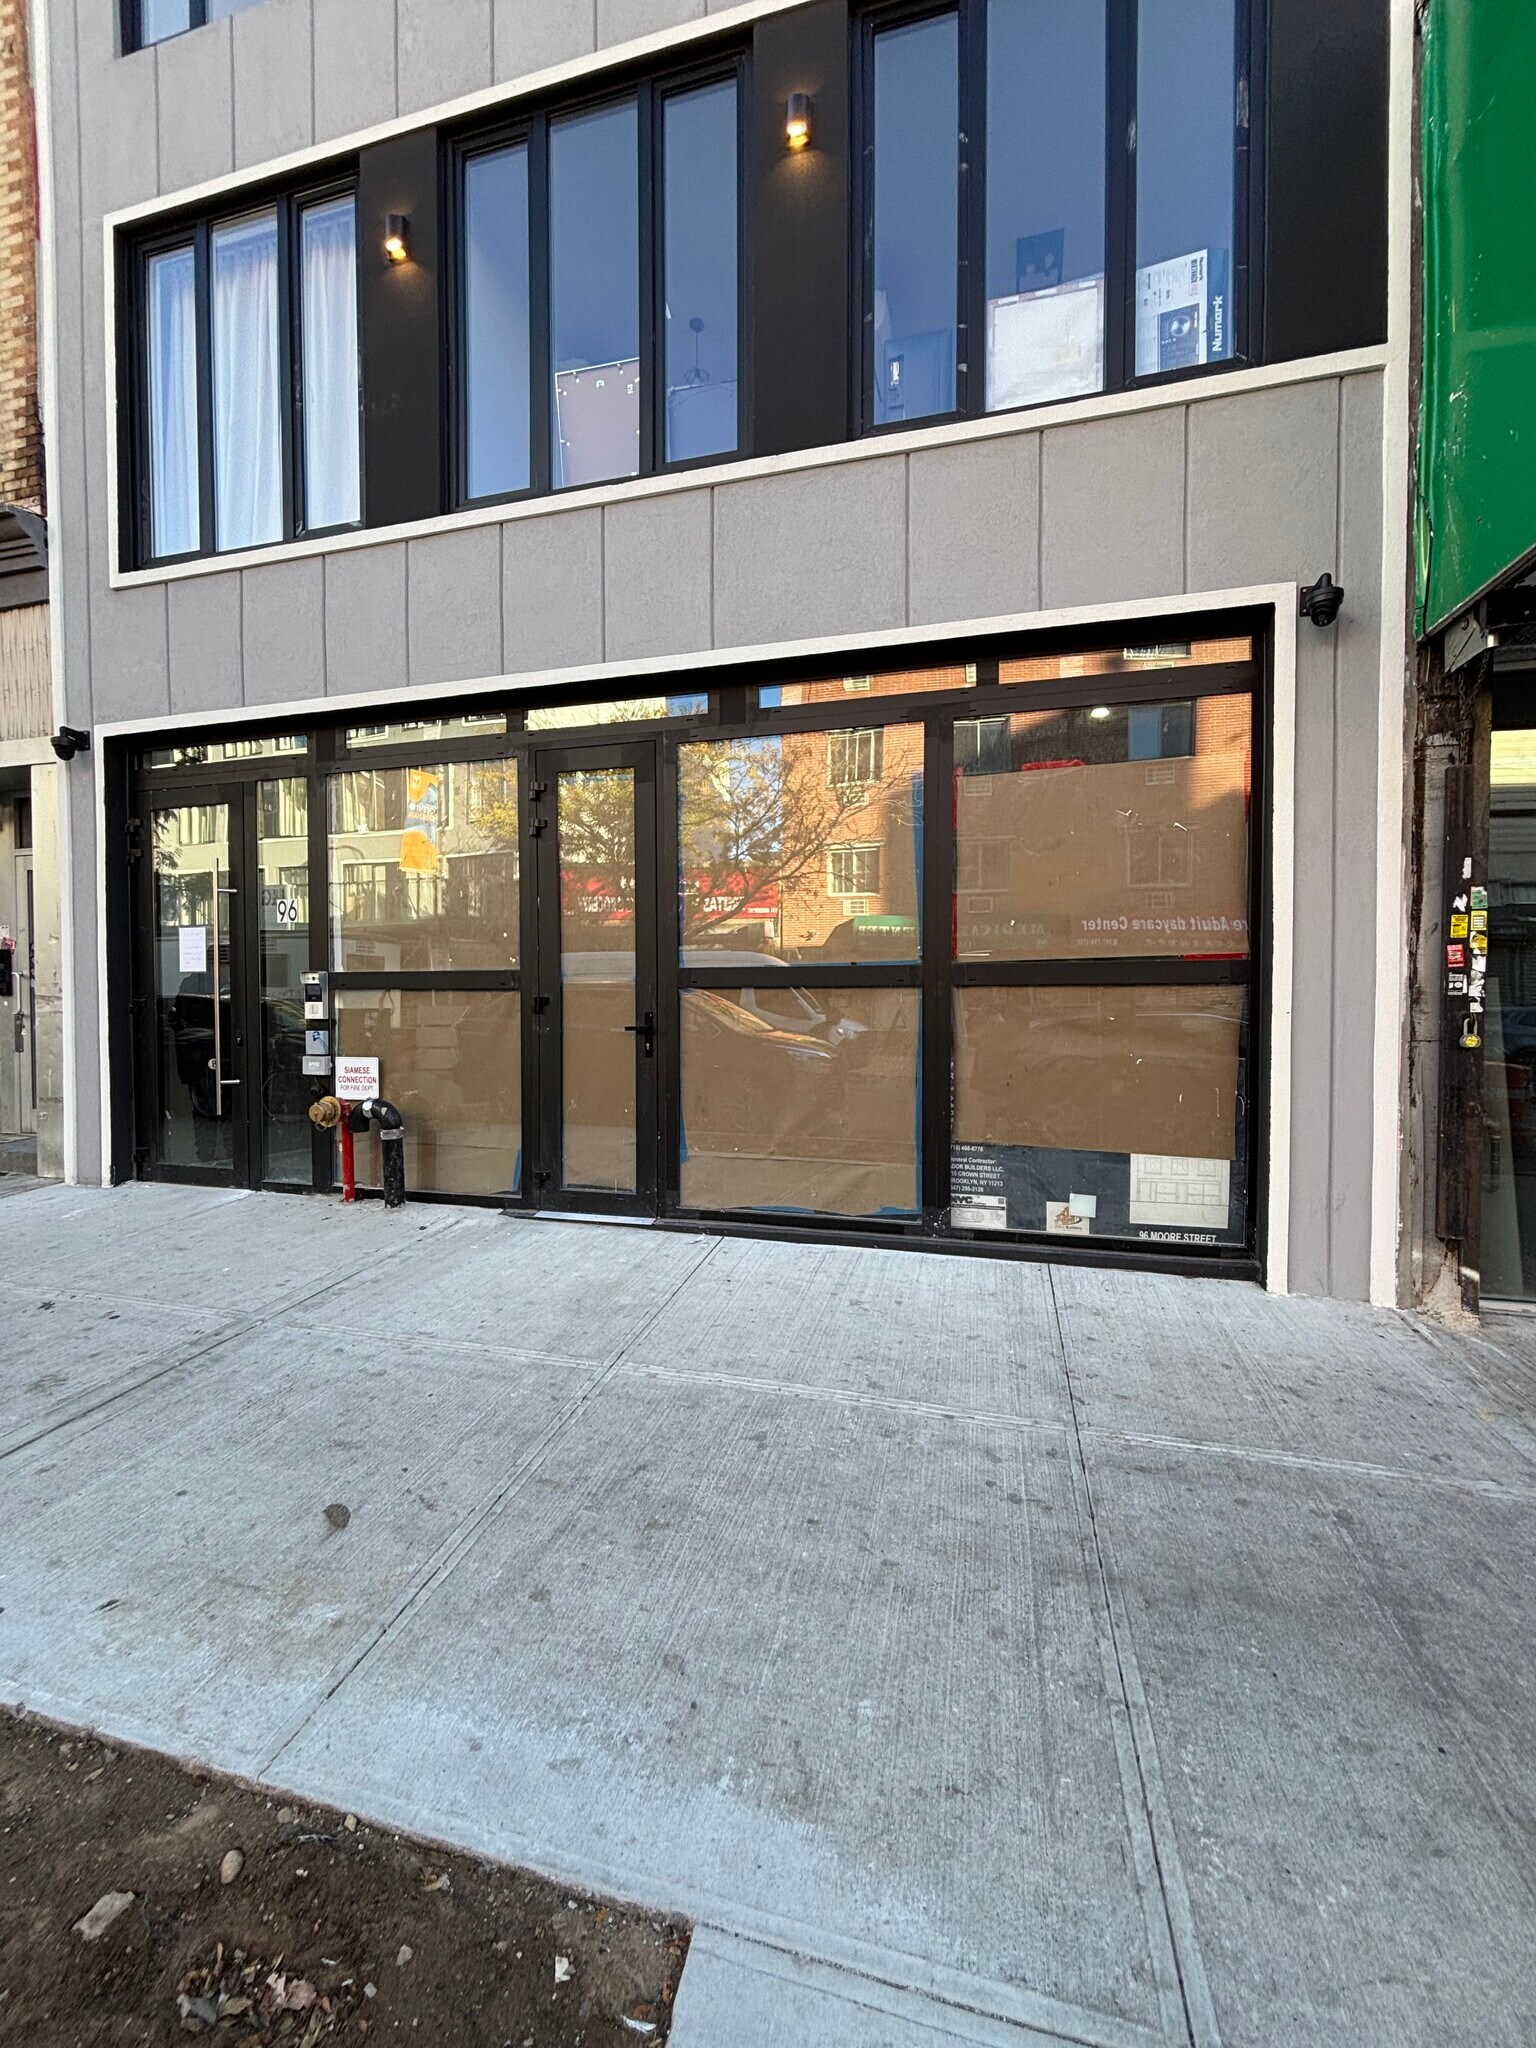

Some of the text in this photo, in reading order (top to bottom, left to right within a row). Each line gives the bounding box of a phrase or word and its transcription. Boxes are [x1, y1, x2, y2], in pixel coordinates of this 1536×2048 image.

[1212, 295, 1223, 352] Numark
[277, 900, 298, 922] 96
[344, 1066, 370, 1075] SIAMESE
[338, 1075, 377, 1084] CONNECTION
[350, 1084, 361, 1092] FIRE
[958, 1170, 979, 1178] CROWN
[979, 1171, 1001, 1179] STREET
[951, 1178, 978, 1186] ROOKLYN,
[1138, 1230, 1218, 1243] 96 MOORE STREET
